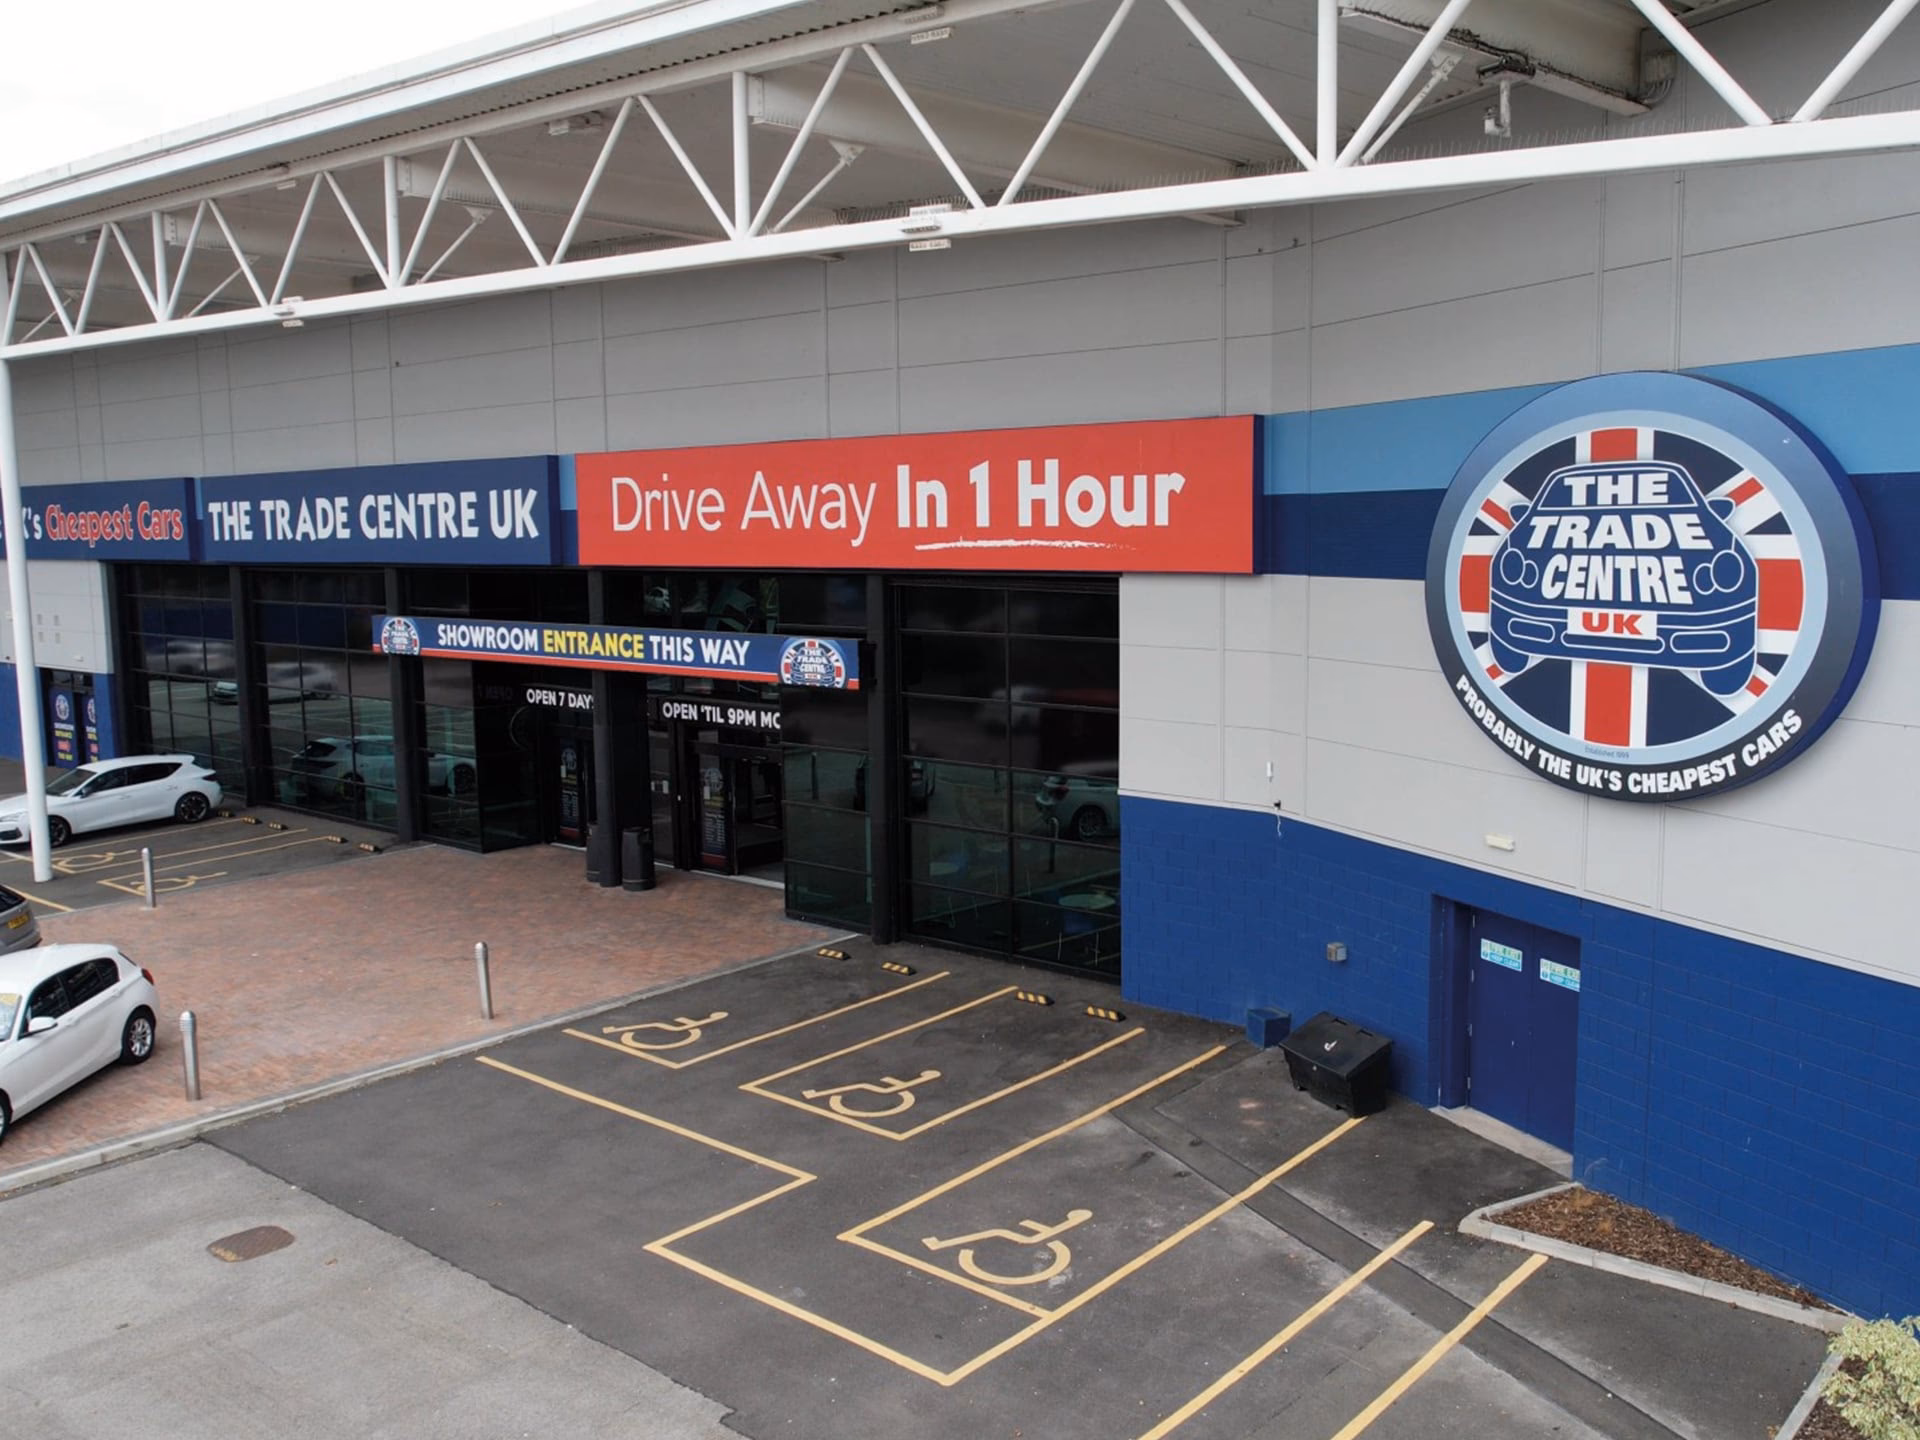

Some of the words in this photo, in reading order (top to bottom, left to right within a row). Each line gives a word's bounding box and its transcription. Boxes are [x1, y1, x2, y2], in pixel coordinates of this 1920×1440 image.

[611, 472, 725, 533] Drive
[740, 470, 877, 547] Away
[896, 463, 948, 529] In
[968, 460, 990, 529] 1
[1017, 457, 1185, 529] Hour
[1562, 472, 1670, 506] THE
[45, 504, 133, 548] Cheapest
[137, 501, 184, 541] Cars
[208, 501, 253, 541] THE
[260, 497, 350, 542] TRADE
[359, 492, 479, 541] CENTRE
[489, 488, 539, 539] UK
[1526, 513, 1714, 551] TRADE
[1540, 555, 1694, 606] CENTRE
[437, 623, 539, 652] SHOWROOM
[543, 629, 645, 660] ENTRANCE
[649, 635, 695, 663] THIS
[700, 638, 750, 666] WAY
[1581, 612, 1644, 636] UK
[526, 688, 557, 706] OPEN
[558, 691, 565, 707] 7
[568, 692, 594, 710] DAY
[662, 701, 698, 721] OPEN
[728, 707, 756, 727] 9PM
[1456, 674, 1535, 760] PROBABLY
[1538, 749, 1571, 779] THE
[1576, 764, 1622, 792] UK'S
[1627, 753, 1738, 794] CHEAPEST
[1741, 708, 1802, 767] CARS
